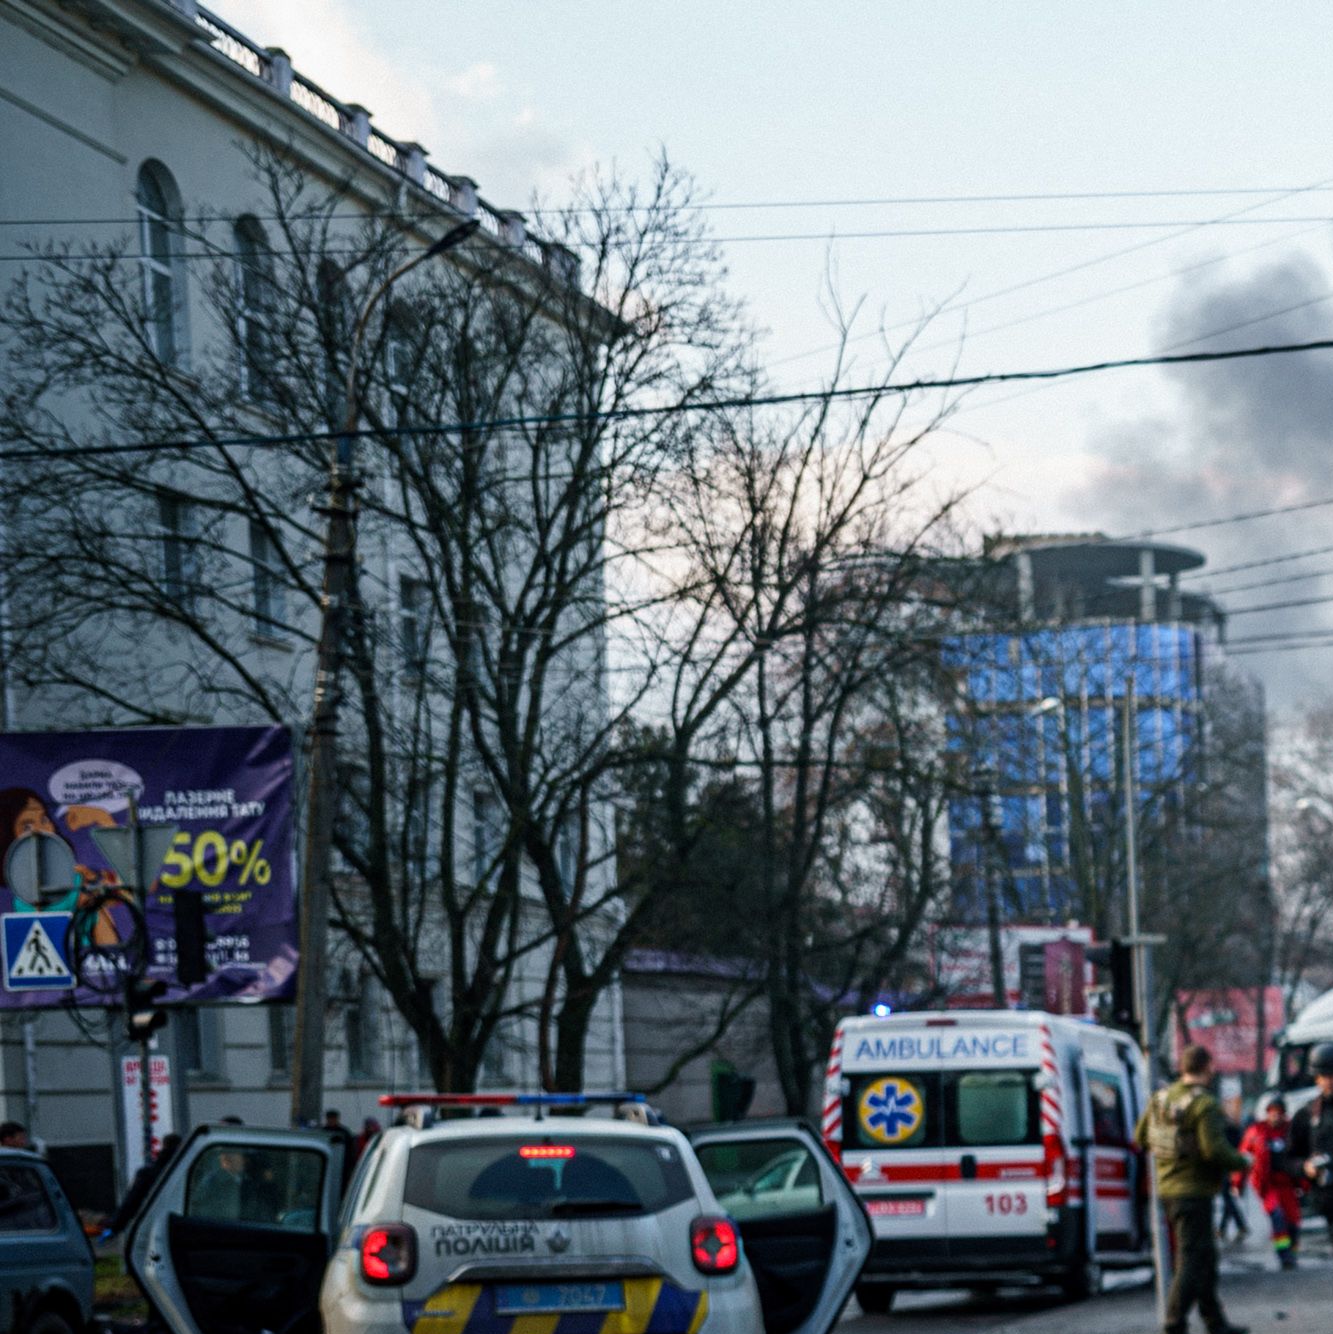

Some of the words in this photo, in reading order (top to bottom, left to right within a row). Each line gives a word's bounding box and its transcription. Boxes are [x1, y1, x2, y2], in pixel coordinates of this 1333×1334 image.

[138, 803, 229, 821] ИДАЛЕННЯ
[160, 830, 272, 888] 50%
[855, 1034, 1028, 1061] AMBULANCE
[985, 1193, 1028, 1216] 103
[430, 1220, 540, 1237] ПАТРУЛЬНА
[435, 1235, 536, 1257] ПОЛІЦІЯ
